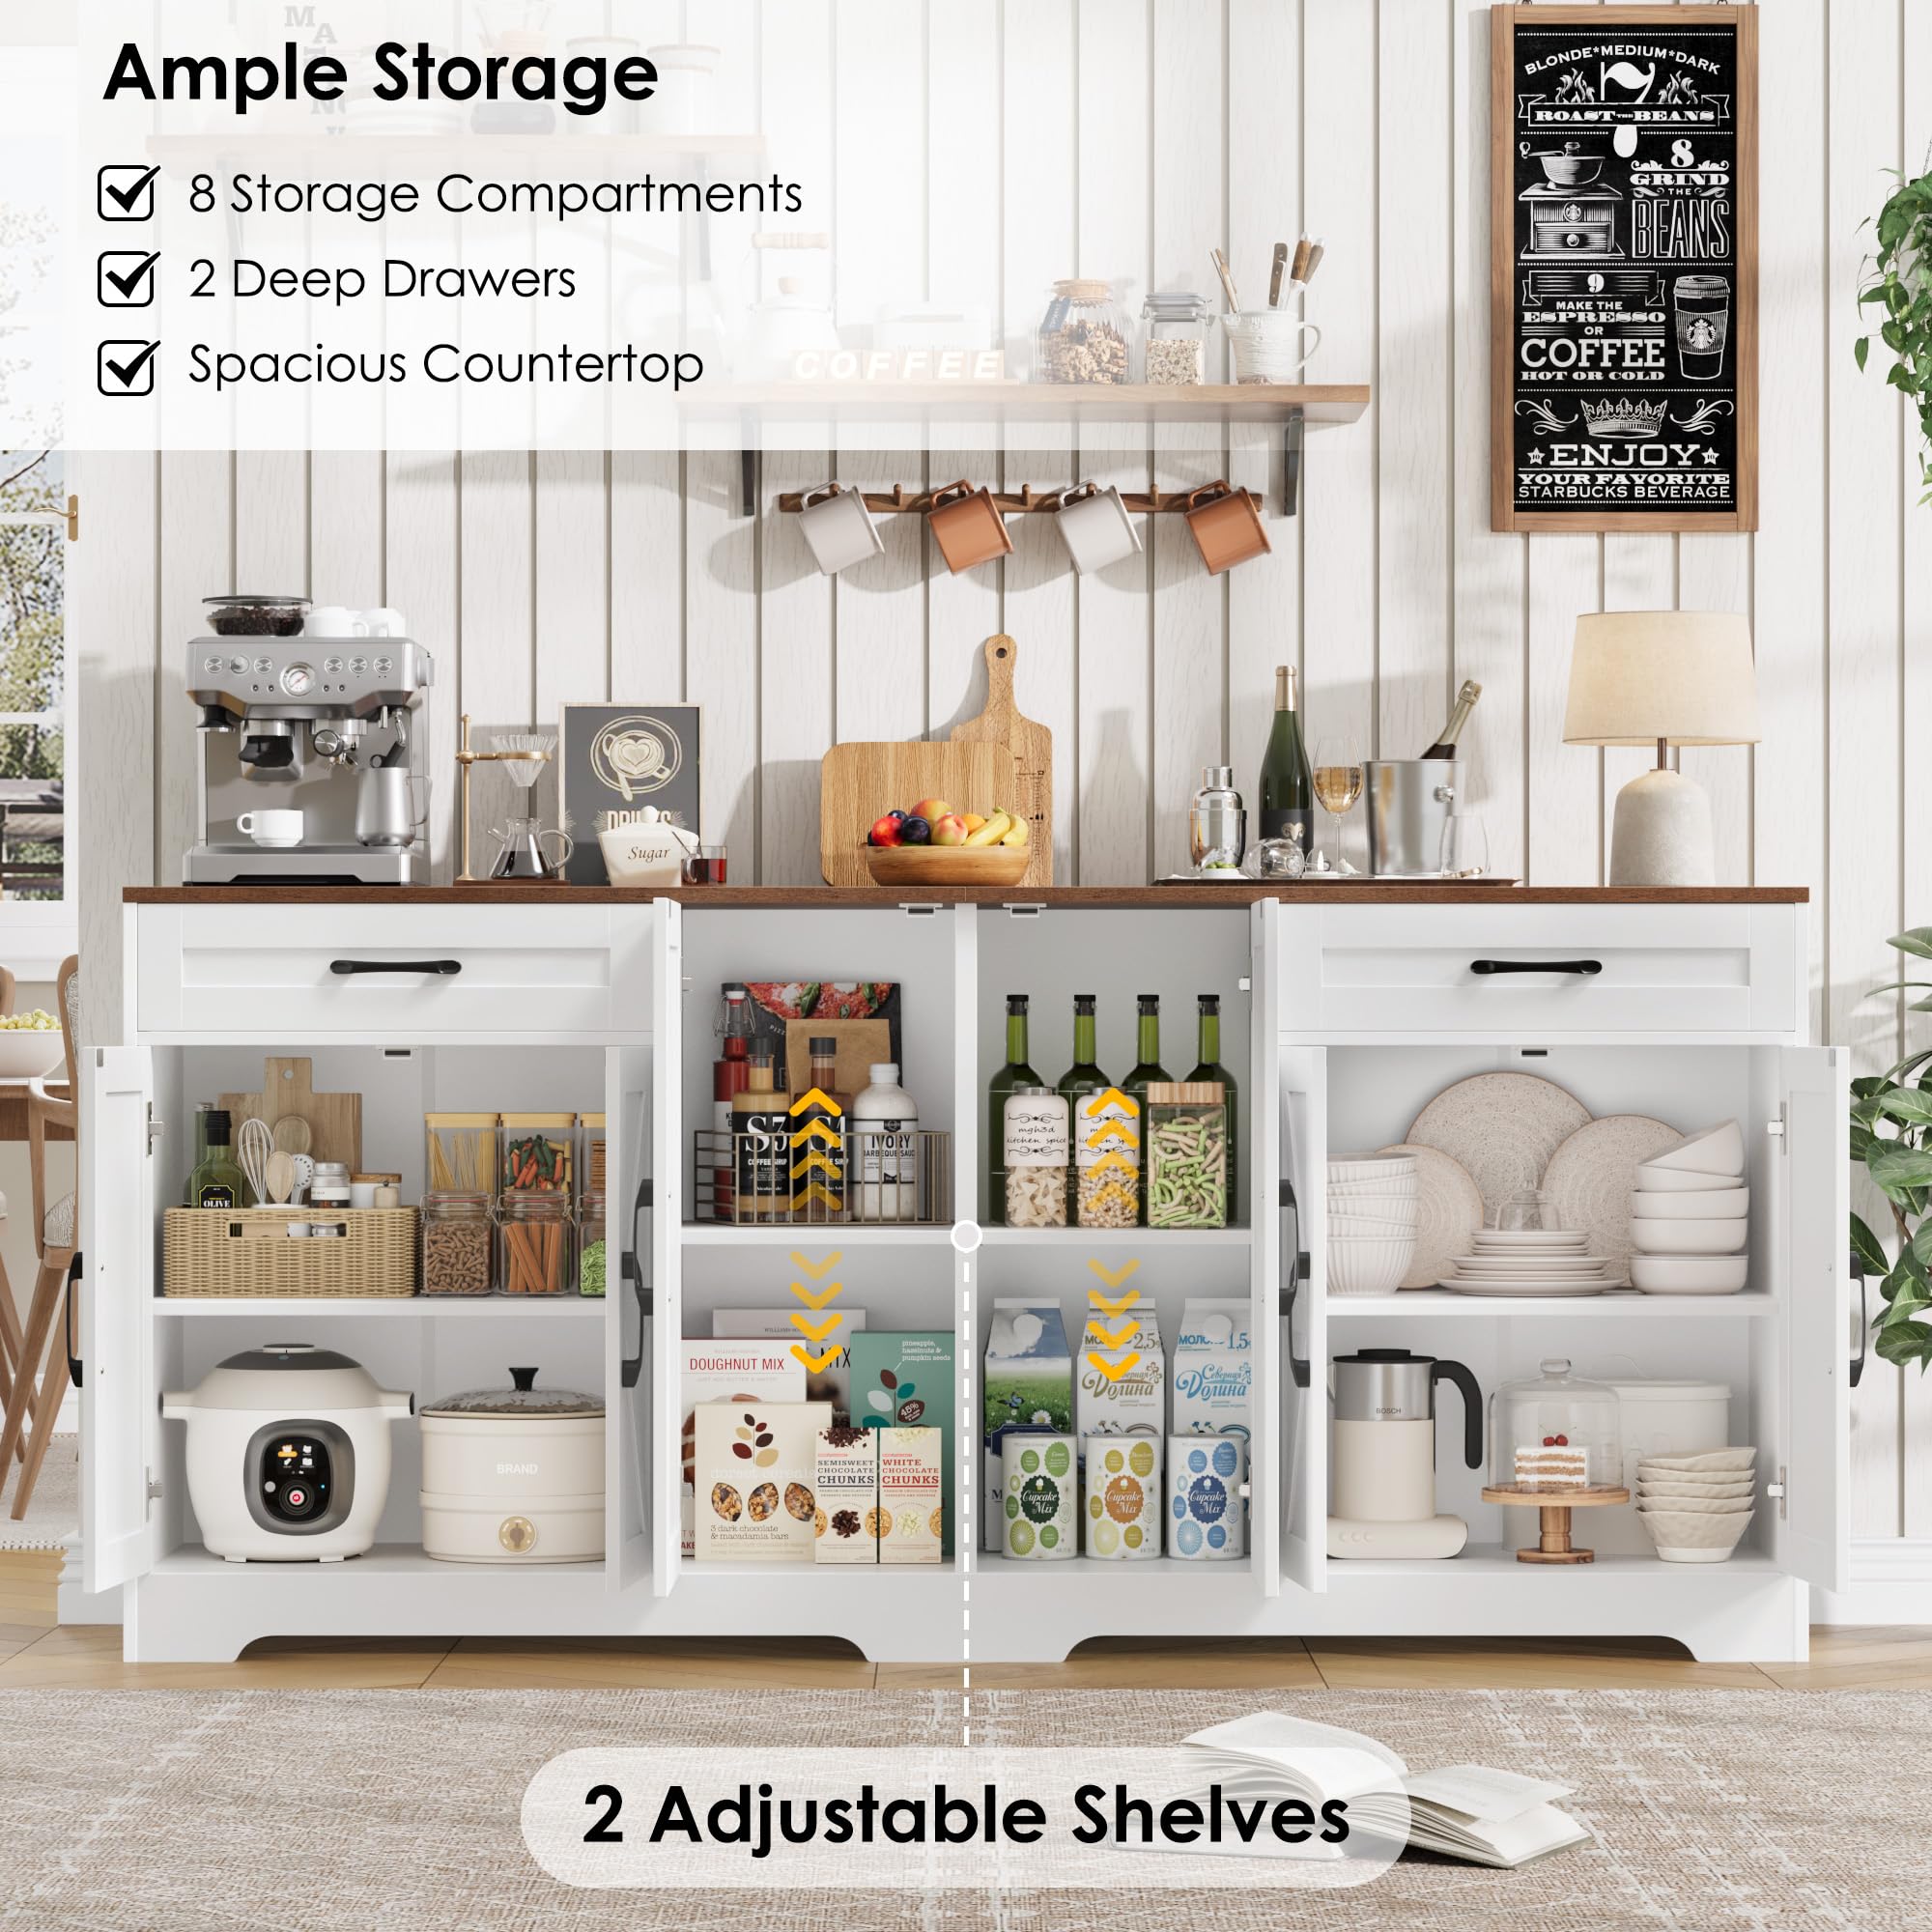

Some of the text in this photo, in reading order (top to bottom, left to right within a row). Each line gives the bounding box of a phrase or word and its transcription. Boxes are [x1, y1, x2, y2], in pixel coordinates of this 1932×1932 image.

[1534, 110, 1616, 122] ROAST
[1633, 109, 1715, 122] BEANS
[1670, 138, 1694, 168] 8
[1630, 173, 1730, 185] GRIND
[1632, 199, 1730, 259] BEANS
[1587, 273, 1605, 293] 9
[1556, 300, 1623, 310] MAKE THE
[1522, 311, 1666, 324] ESPRESSO
[1583, 326, 1604, 335] OR
[1520, 338, 1665, 368] COFFEE
[794, 350, 1002, 380] COFFEE
[1520, 371, 1665, 381] HOT OR COLD
[1549, 443, 1700, 466] ENJOY
[1518, 473, 1730, 485] YOUR FAVORITE
[1519, 486, 1730, 498] STARBUCKS BEVERAGE
[628, 846, 670, 864] Sugar
[690, 1358, 784, 1371] DOUGHNUT MIX
[497, 1463, 539, 1475] BRAND
[817, 1475, 874, 1485] CHUNKS
[882, 1475, 939, 1485] CHUNKS
